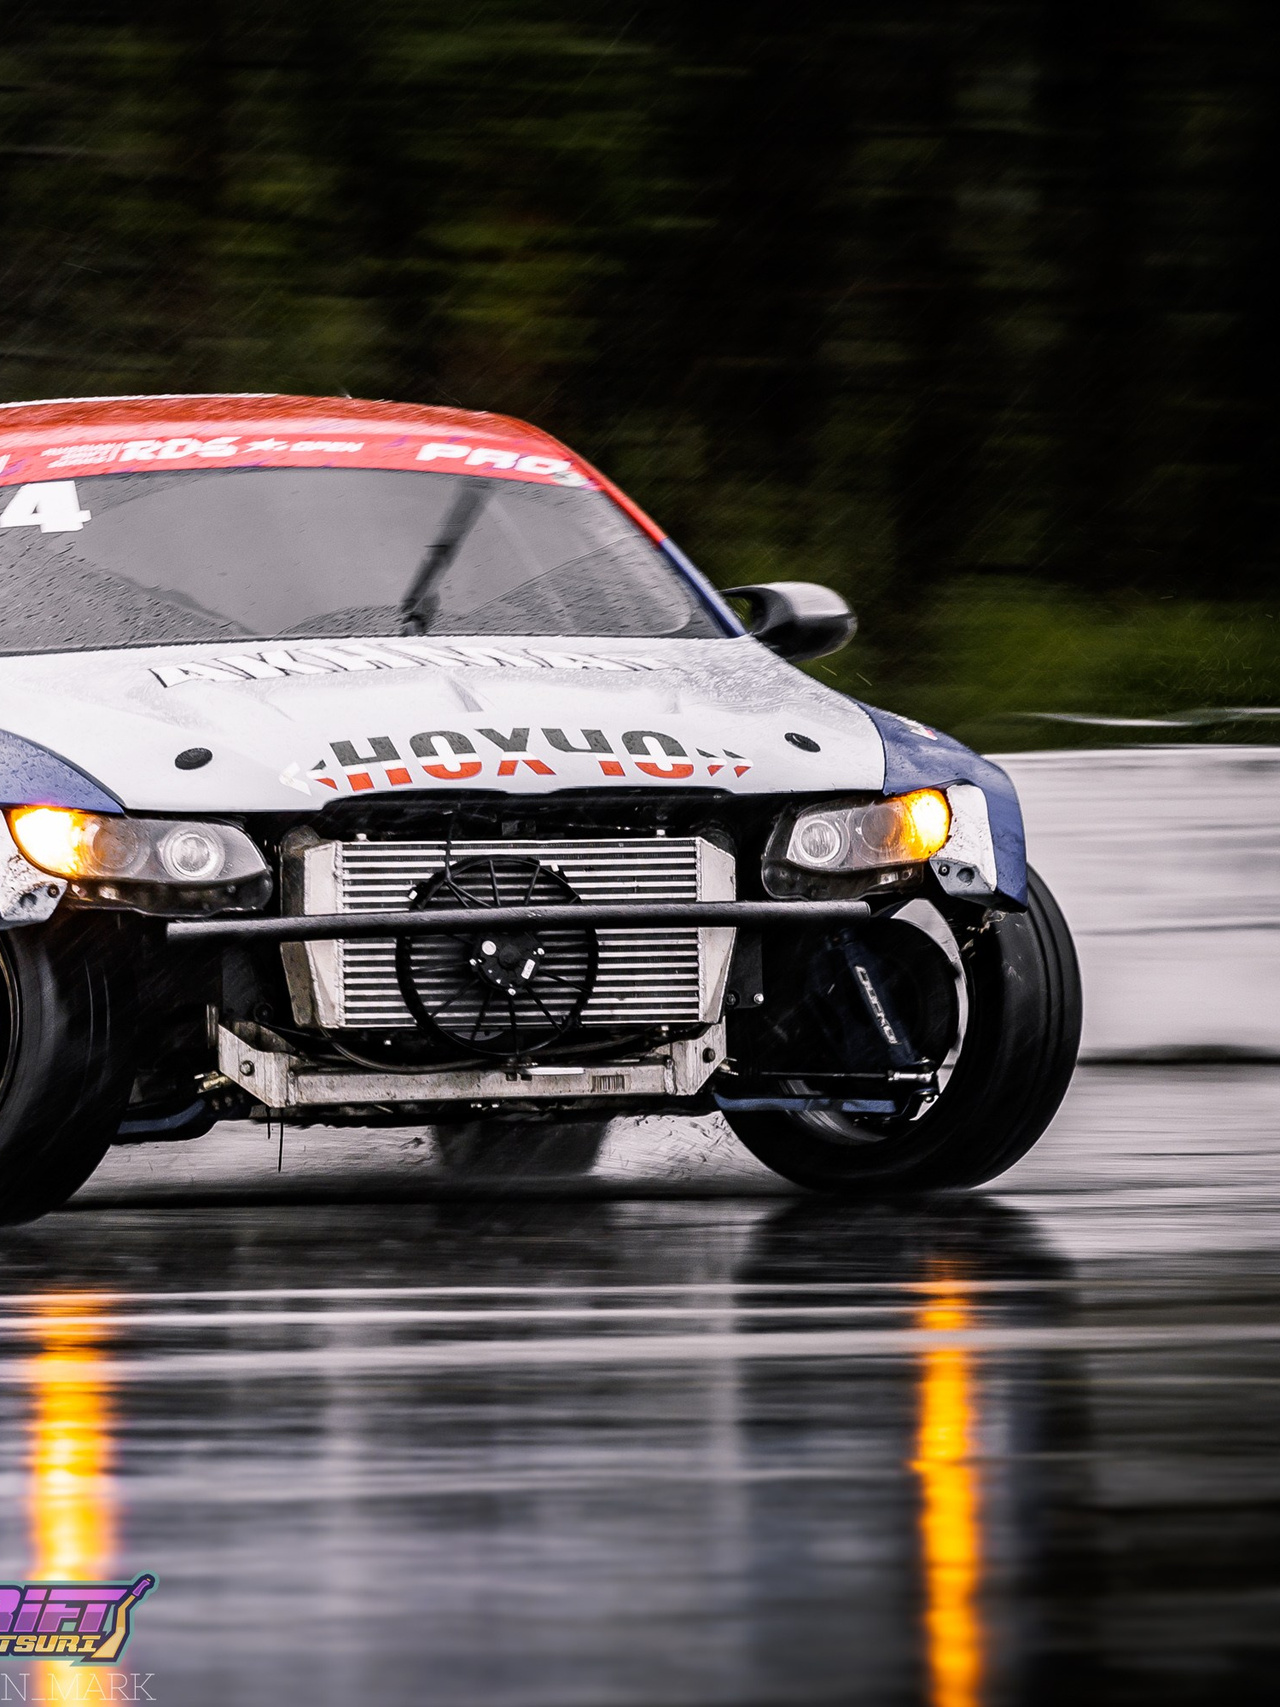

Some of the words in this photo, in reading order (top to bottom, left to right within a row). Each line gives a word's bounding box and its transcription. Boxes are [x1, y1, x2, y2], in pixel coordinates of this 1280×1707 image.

[118, 436, 243, 462] RDS
[288, 441, 366, 452] OPEN
[415, 442, 572, 475] PRO
